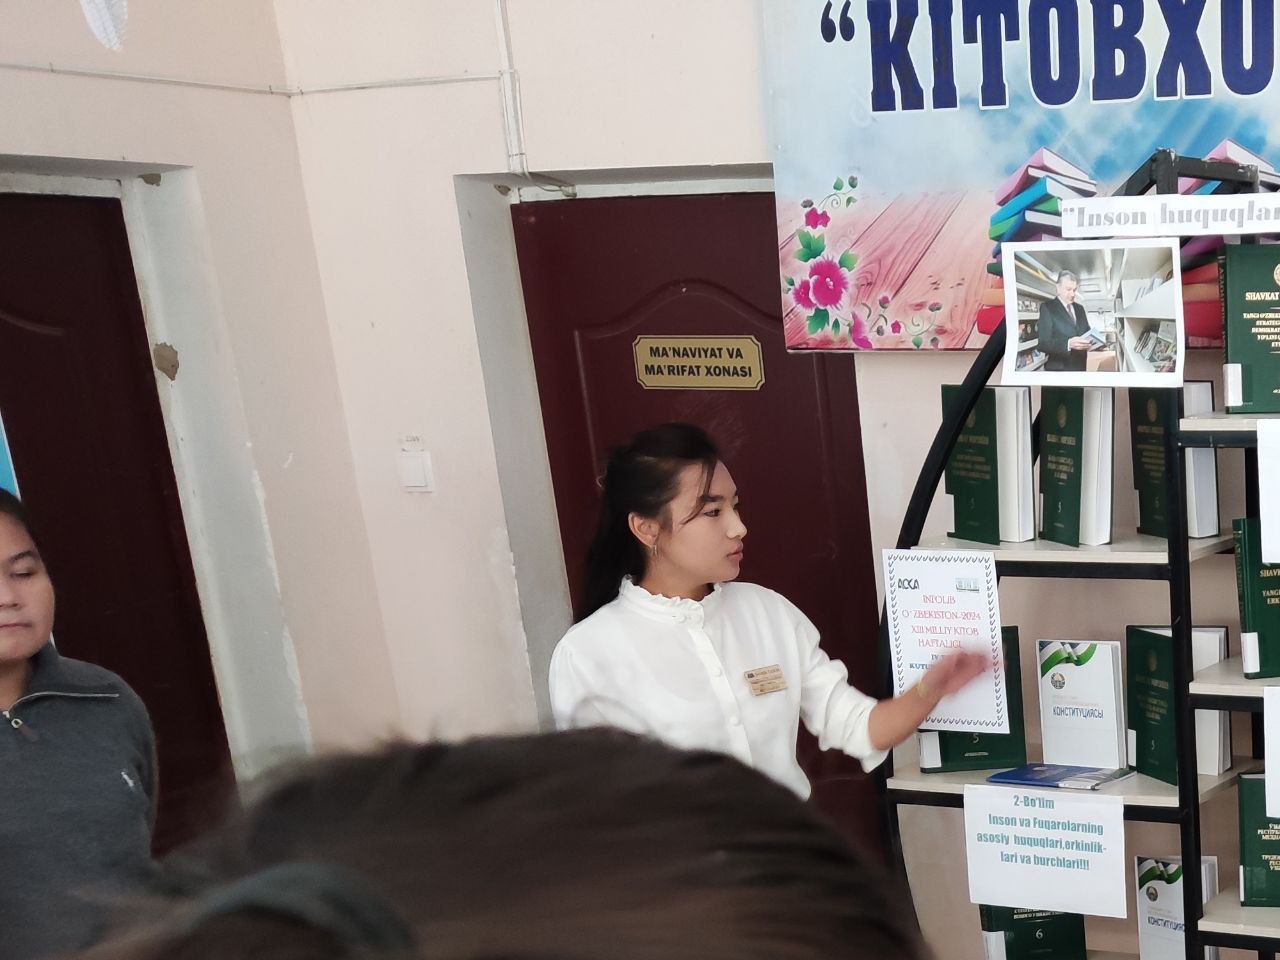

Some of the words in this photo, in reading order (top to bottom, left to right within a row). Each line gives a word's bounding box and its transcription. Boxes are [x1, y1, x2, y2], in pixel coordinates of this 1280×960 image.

[1245, 291, 1280, 301] SHAVKAT
[726, 347, 743, 359] VA
[704, 365, 753, 377] XONASI
[953, 627, 979, 636] KITOB
[988, 814, 1017, 827] Inson
[1019, 818, 1030, 827] va
[1033, 817, 1104, 836] Fuqarolarning
[977, 832, 1010, 845] asosiy
[1020, 856, 1031, 865] va
